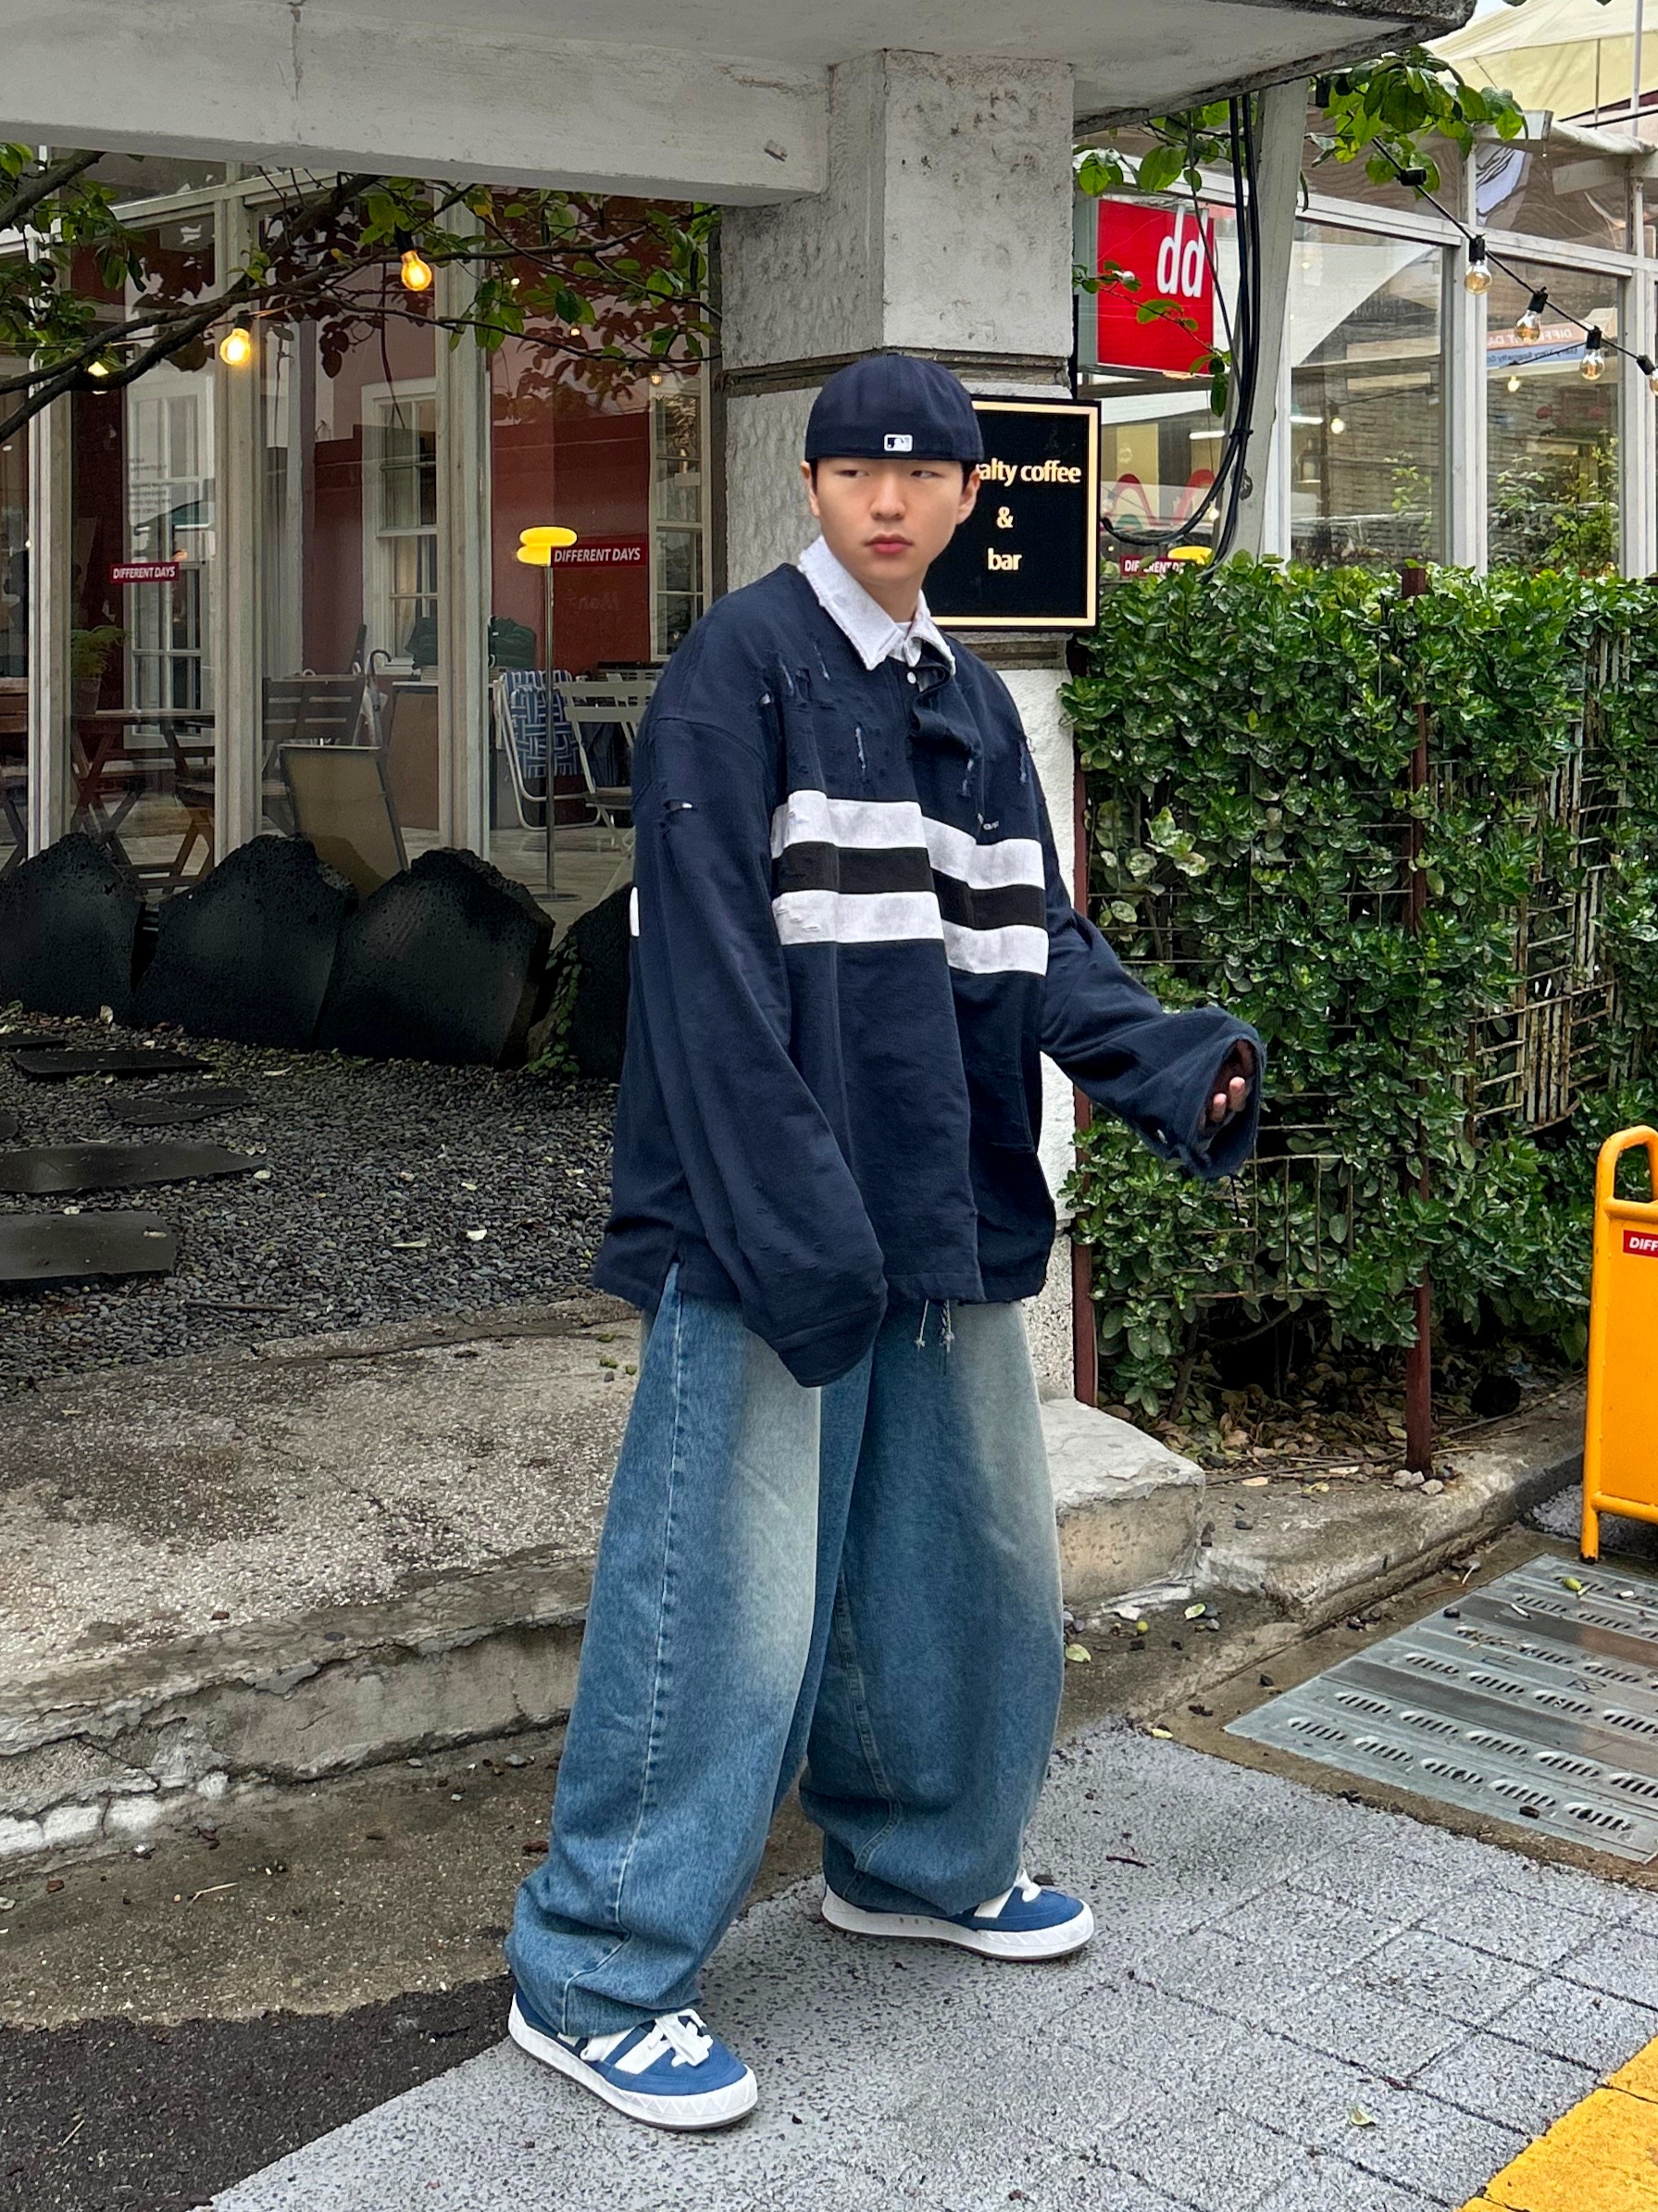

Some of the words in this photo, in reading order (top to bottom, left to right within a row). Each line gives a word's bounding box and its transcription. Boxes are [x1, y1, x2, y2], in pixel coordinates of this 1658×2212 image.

[1156, 205, 1209, 298] dd
[1020, 459, 1082, 483] coffee
[996, 506, 1014, 529] &
[554, 548, 612, 563] DIFFERENT
[611, 547, 642, 562] DAYS
[987, 547, 1023, 570] bar
[113, 567, 155, 580] DIFFERENT
[154, 566, 176, 578] DAYS
[1629, 1236, 1658, 1252] DIFF
